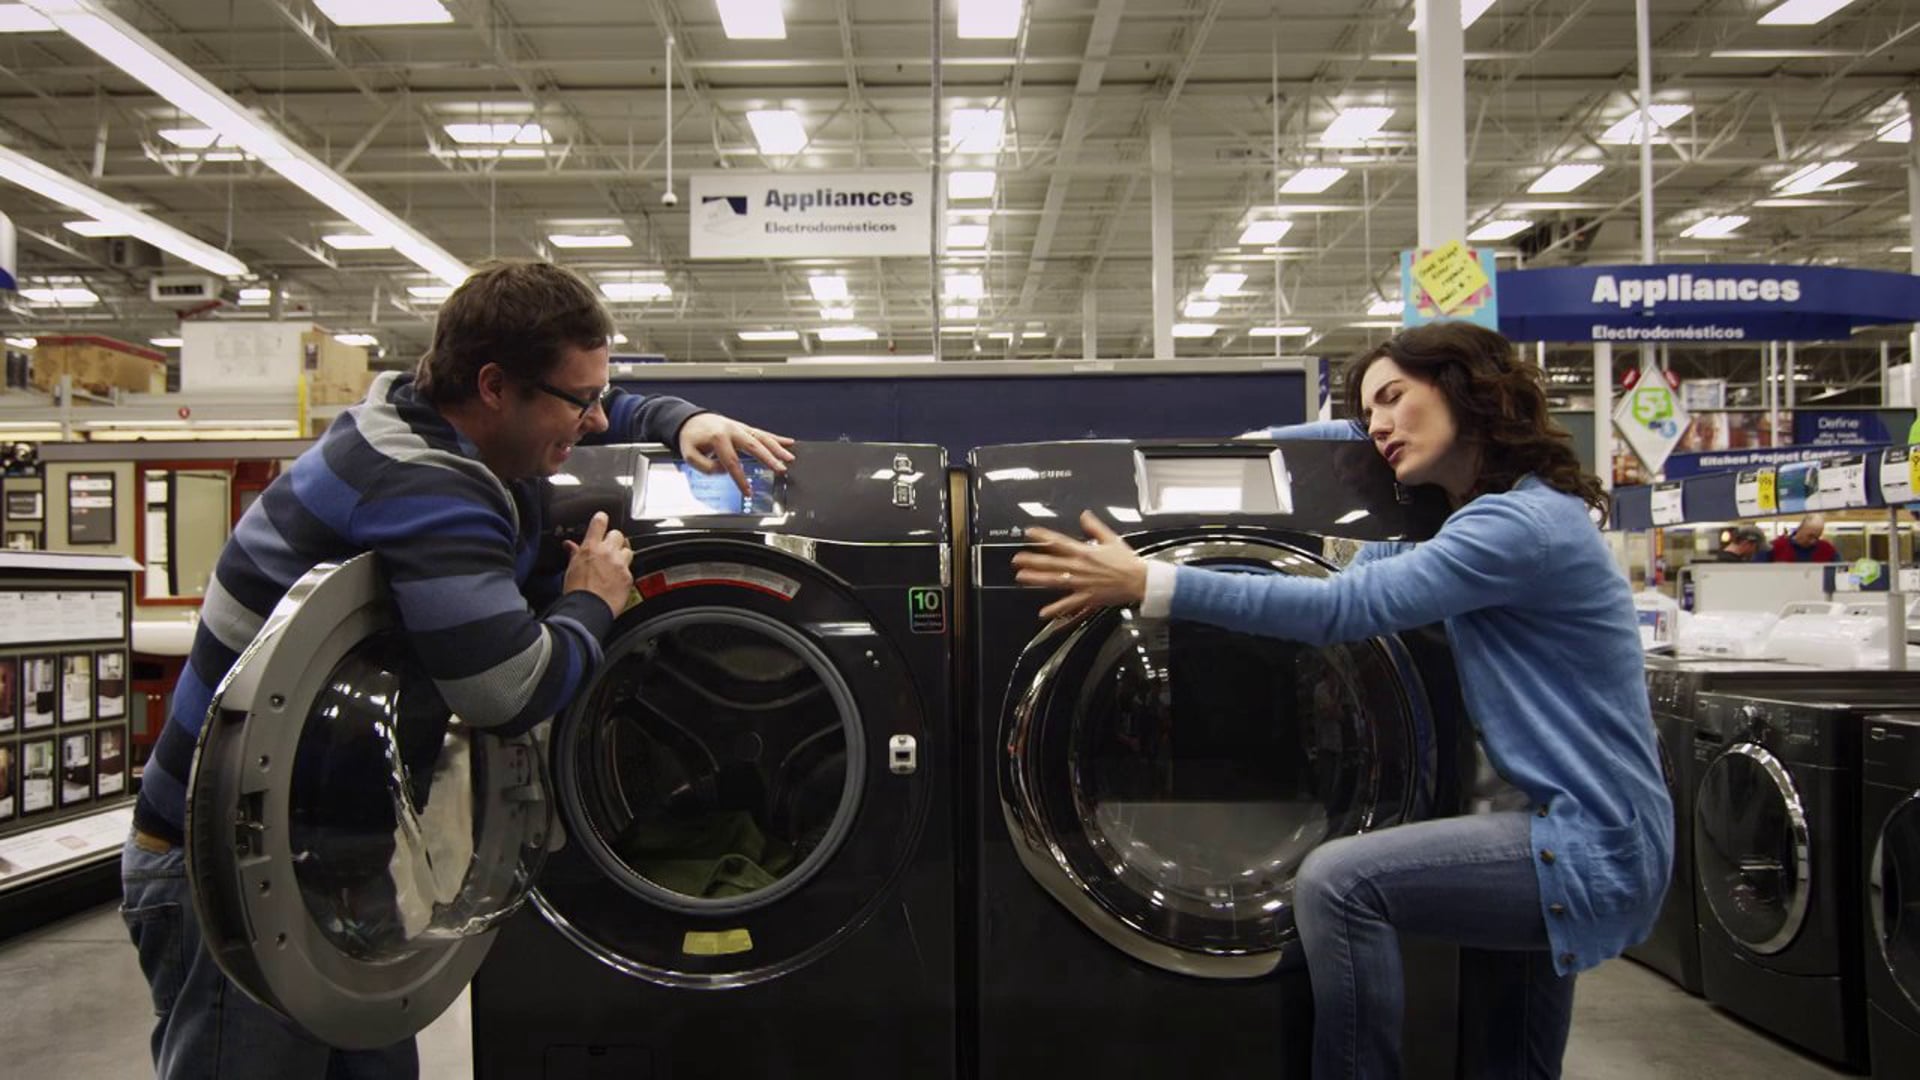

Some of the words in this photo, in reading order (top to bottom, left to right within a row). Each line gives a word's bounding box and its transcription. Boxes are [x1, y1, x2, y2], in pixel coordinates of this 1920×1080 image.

[765, 189, 914, 212] Appliances
[765, 221, 896, 234] Electrodomésticos
[1592, 274, 1800, 308] Appliances
[1592, 324, 1744, 340] Electrodomésticos
[1818, 416, 1859, 429] Define
[1699, 455, 1748, 467] Kitchen
[1750, 451, 1800, 465] Project
[914, 591, 940, 611] 10
